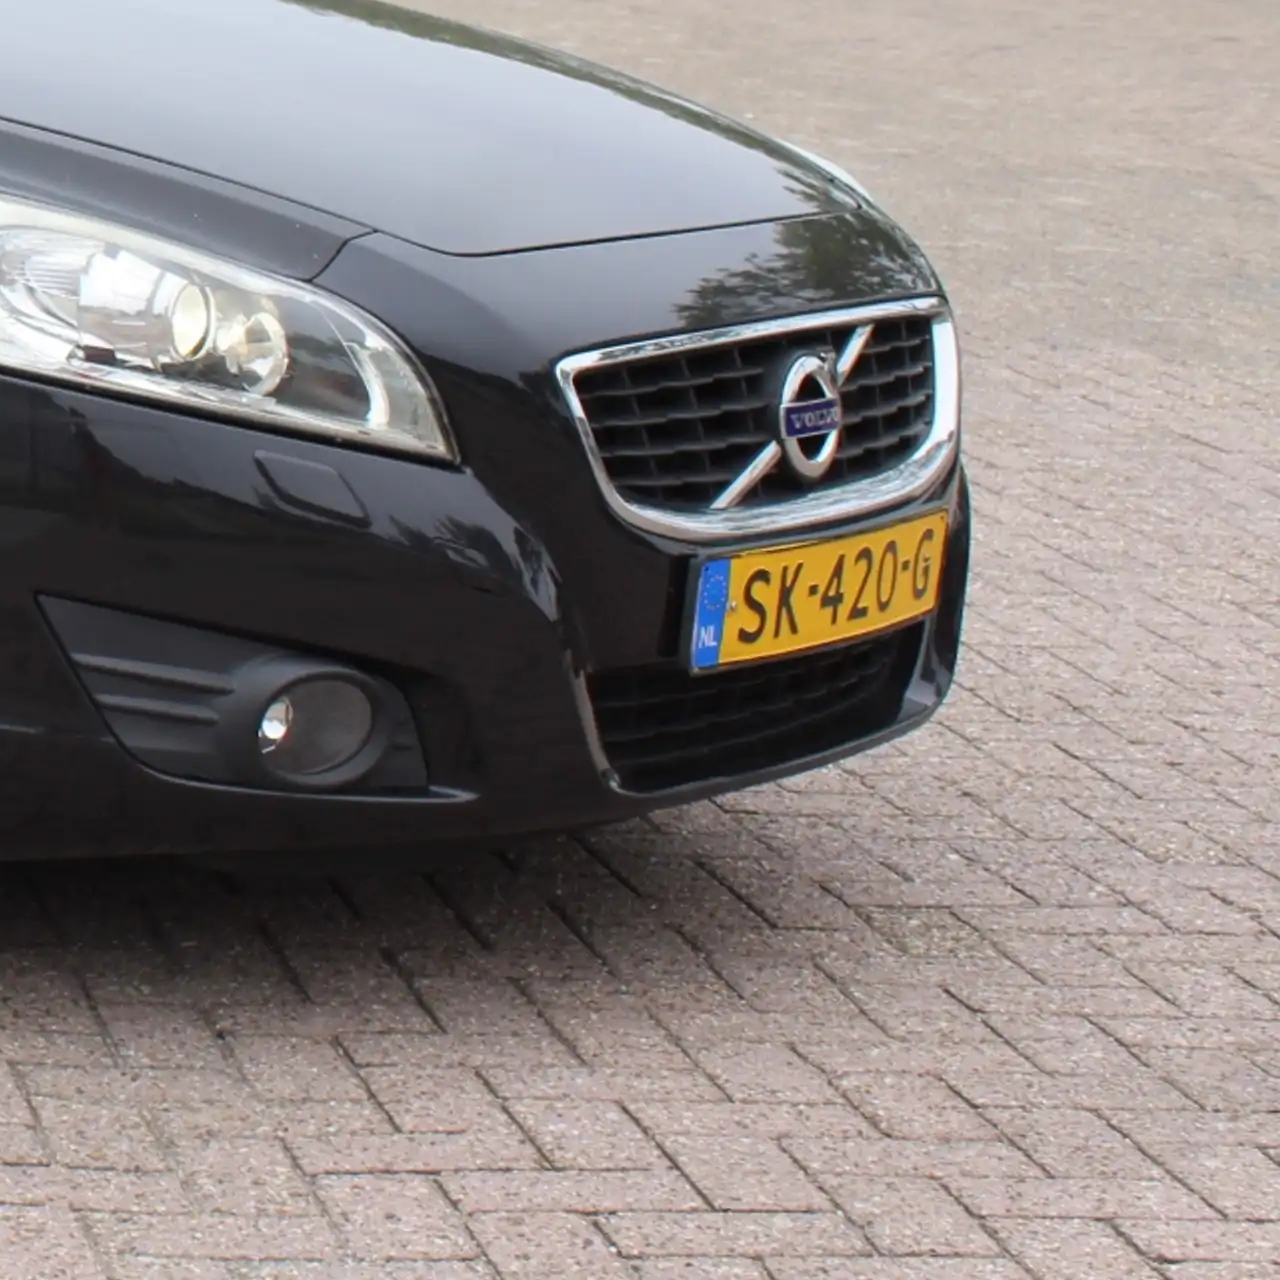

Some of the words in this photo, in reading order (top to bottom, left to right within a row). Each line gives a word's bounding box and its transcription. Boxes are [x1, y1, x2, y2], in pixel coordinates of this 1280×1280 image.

[790, 406, 839, 430] VOLVO
[737, 528, 934, 645] SK-420-G
[698, 625, 718, 648] NL
